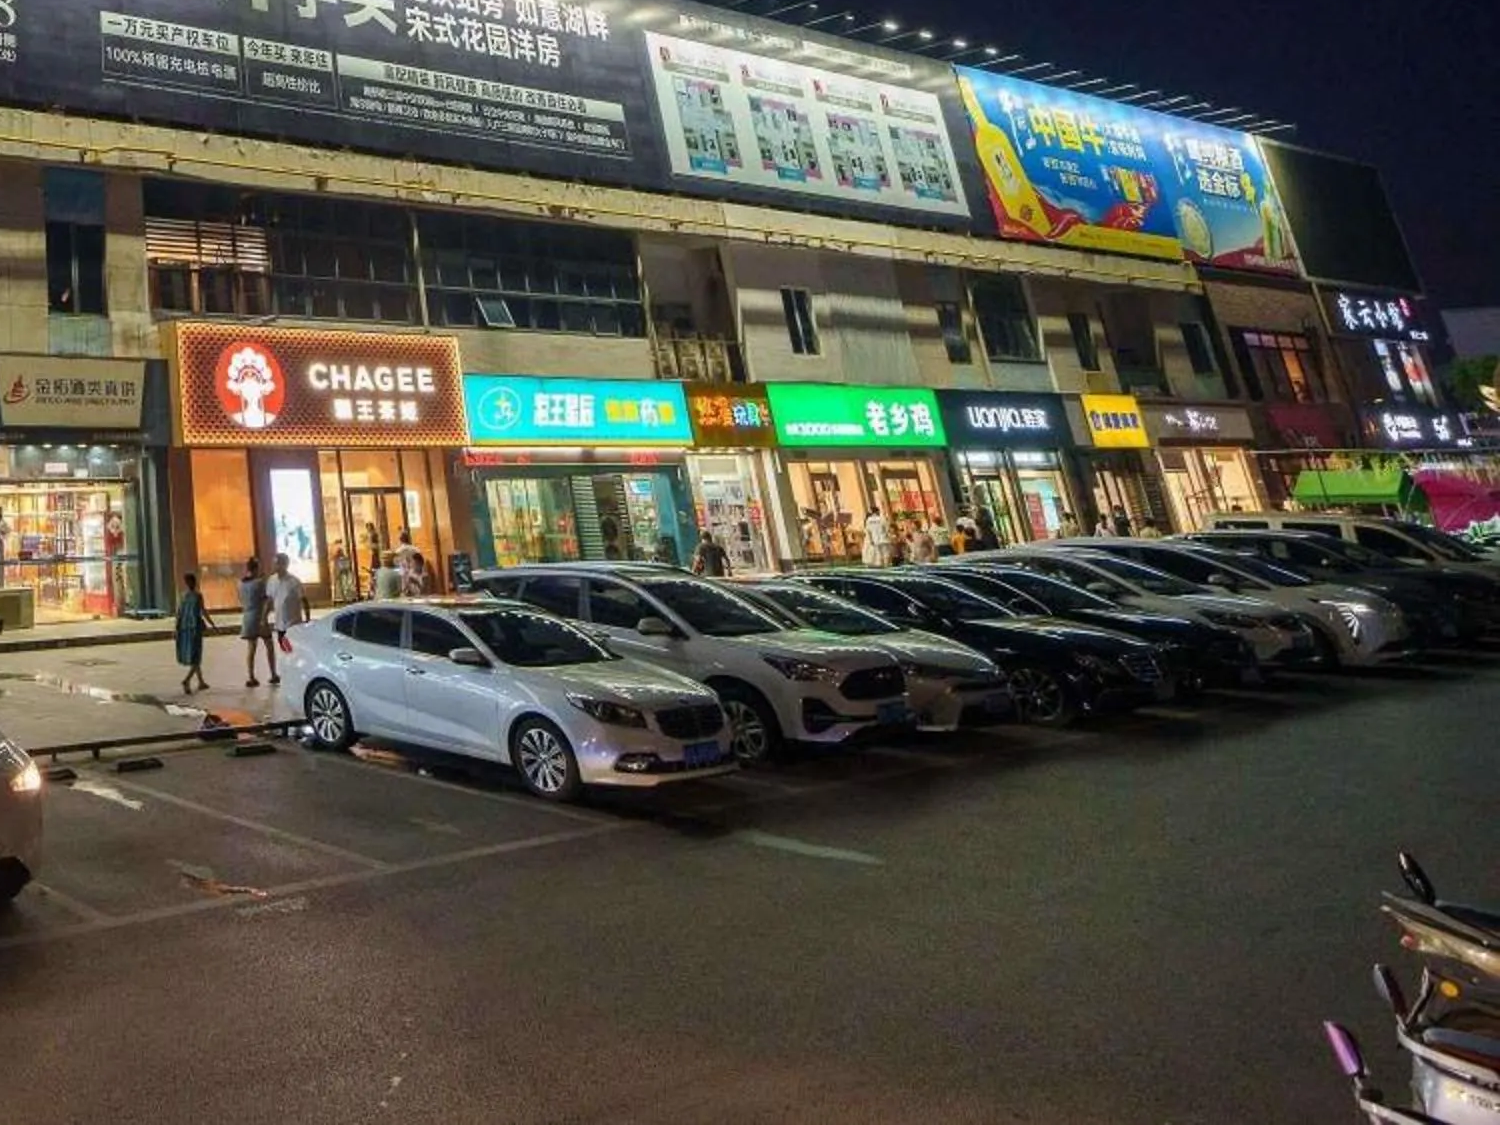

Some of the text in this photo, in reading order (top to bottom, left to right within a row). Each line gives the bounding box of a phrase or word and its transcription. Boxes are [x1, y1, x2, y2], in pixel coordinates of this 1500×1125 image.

[406, 7, 561, 68] 宋式花园洋房
[309, 362, 435, 392] CHAGEE
